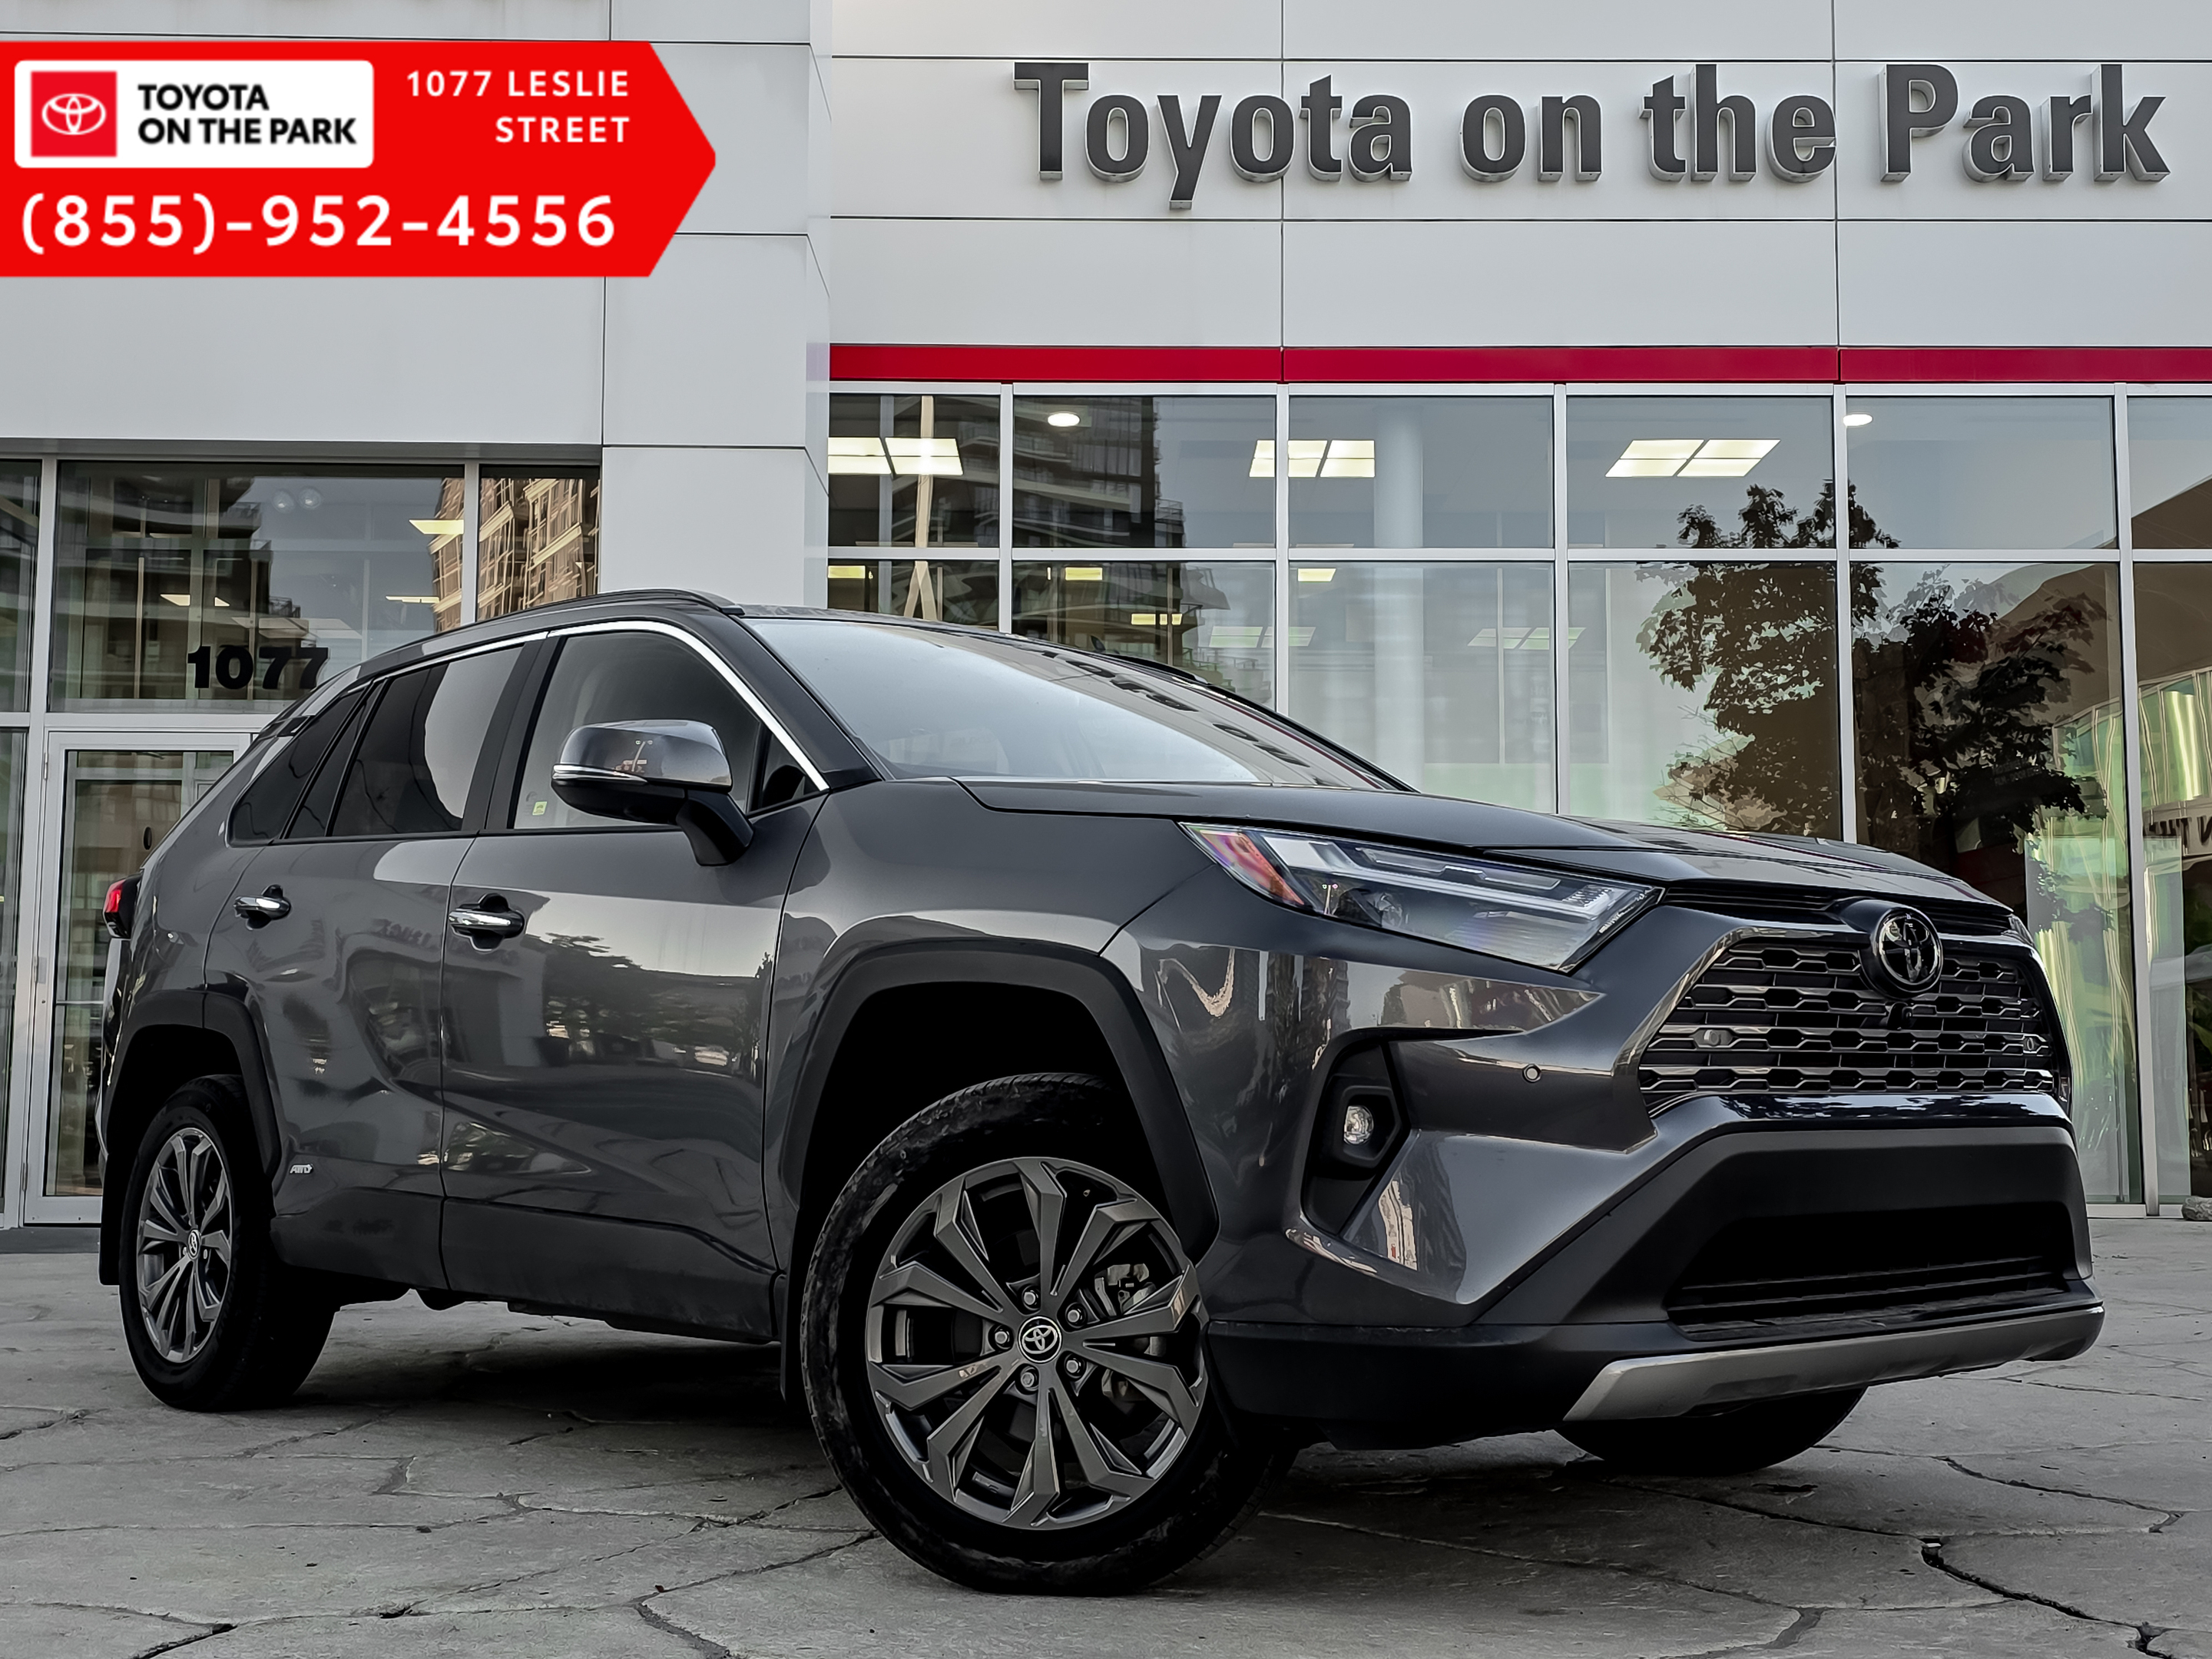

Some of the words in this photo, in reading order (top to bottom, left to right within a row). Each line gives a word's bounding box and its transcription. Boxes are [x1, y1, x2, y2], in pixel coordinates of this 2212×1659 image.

[1014, 61, 1412, 210] Toyota
[1461, 92, 1603, 183] on
[1641, 62, 1836, 183] the
[1879, 62, 2169, 183] Park
[187, 645, 329, 690] 1077
